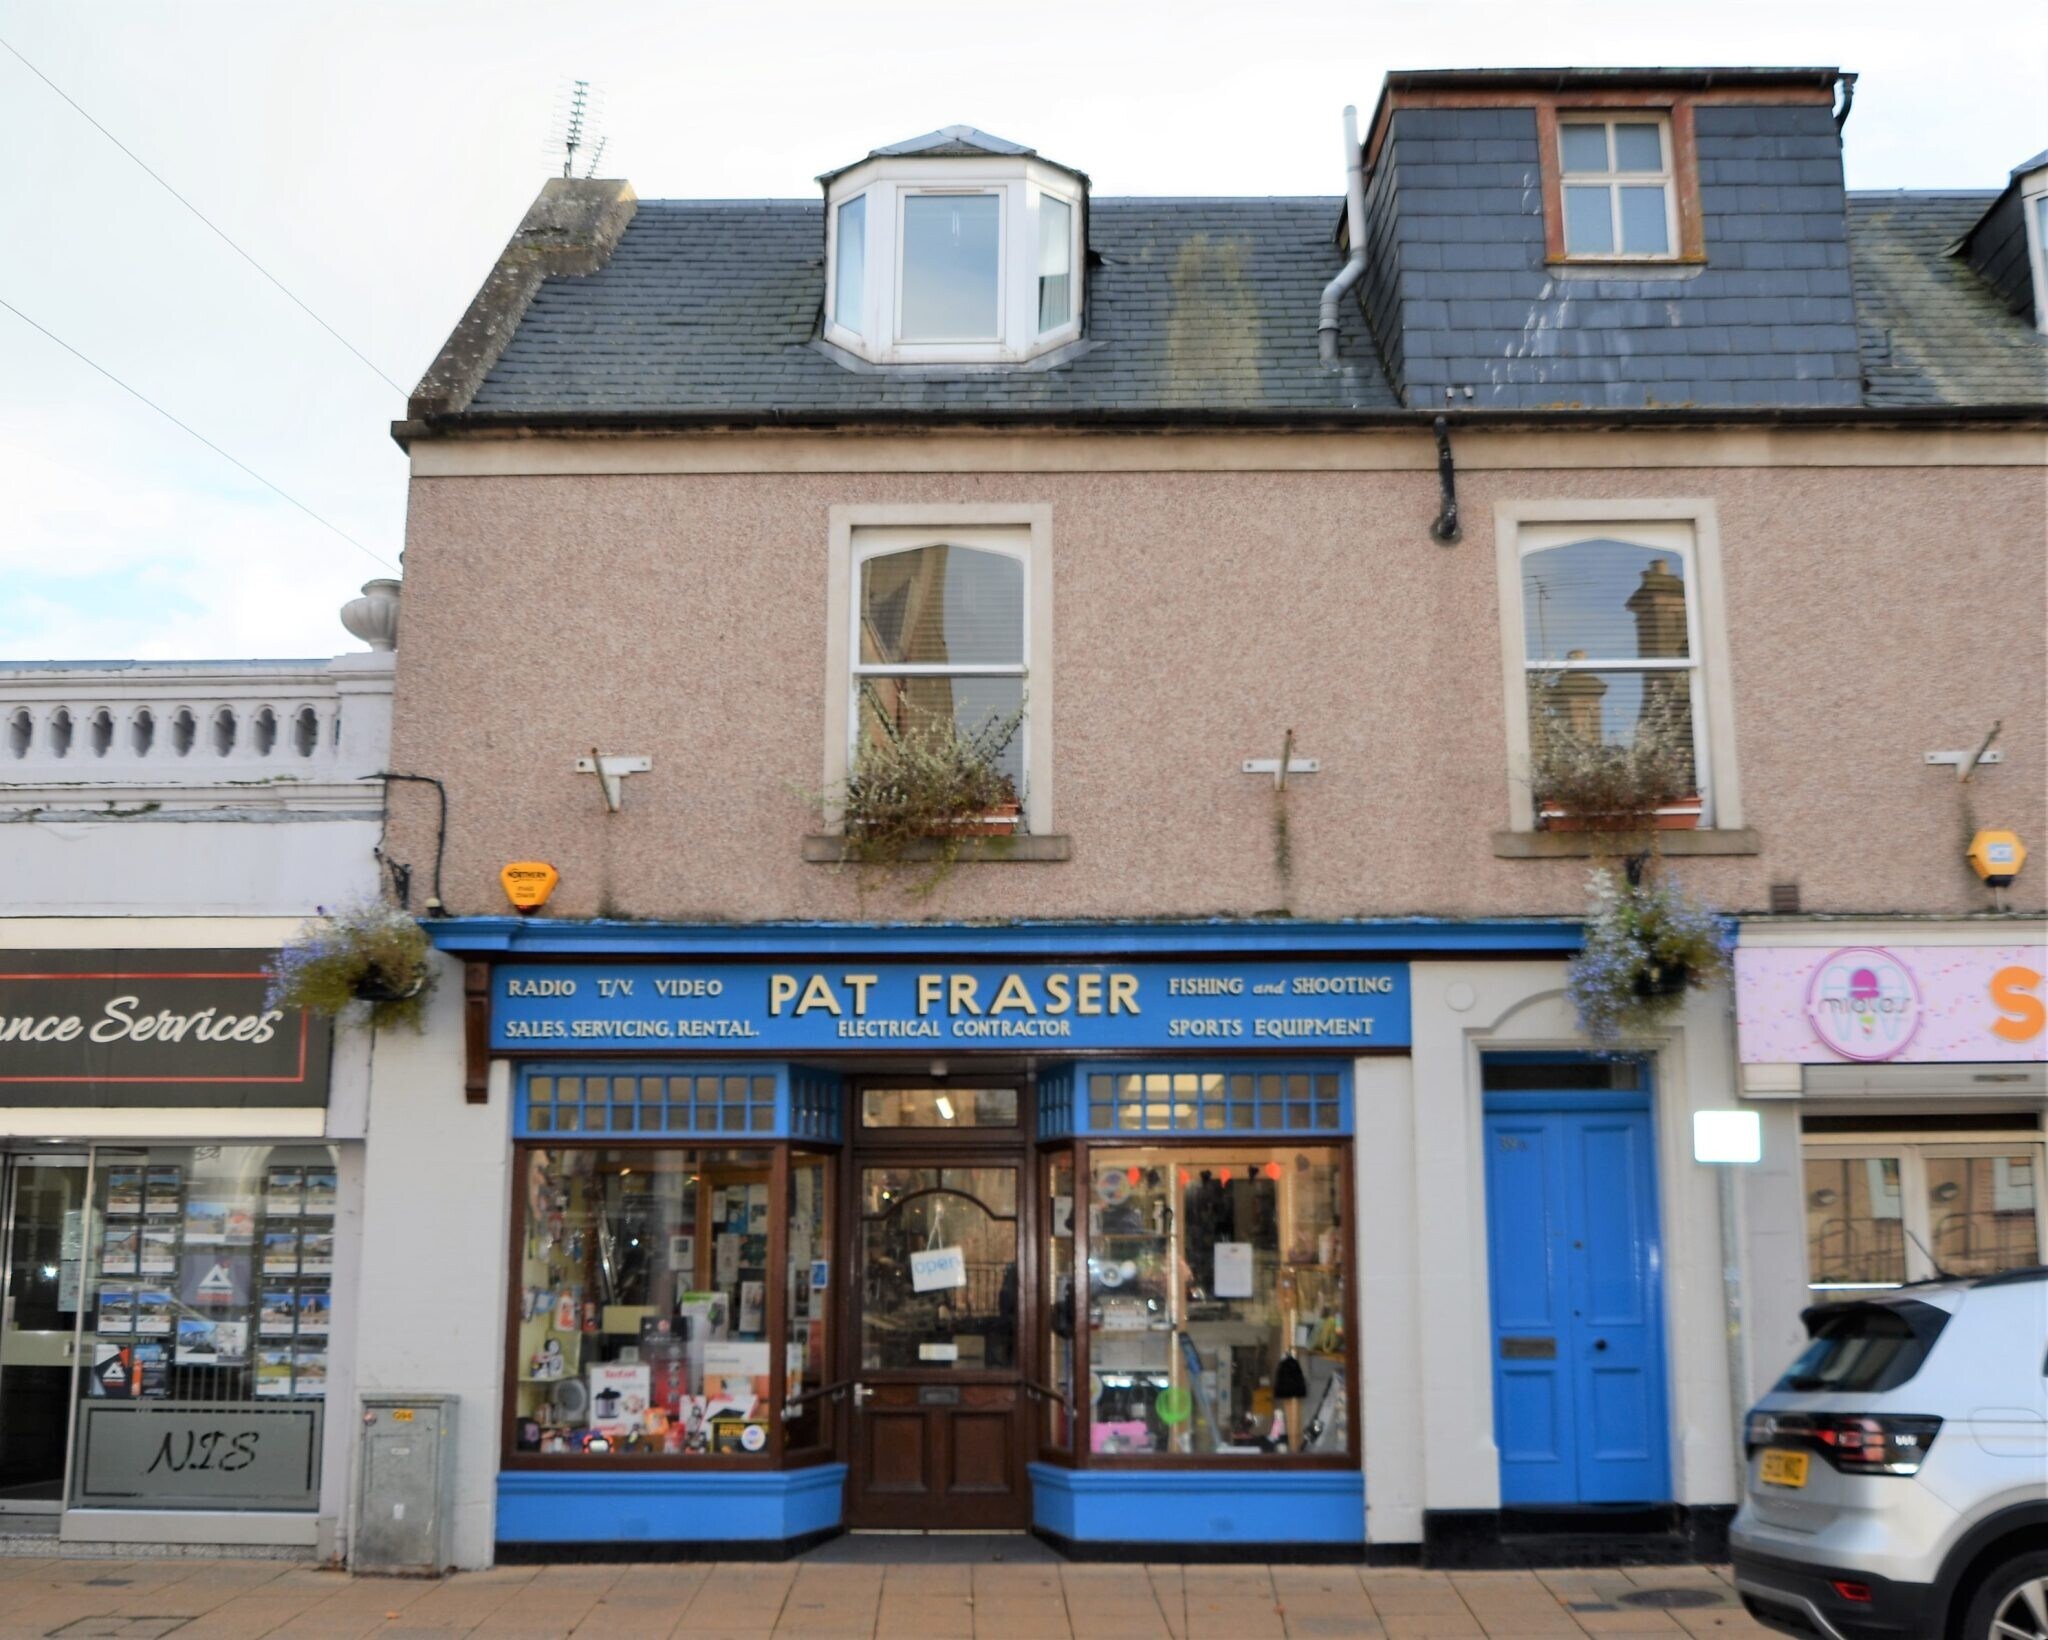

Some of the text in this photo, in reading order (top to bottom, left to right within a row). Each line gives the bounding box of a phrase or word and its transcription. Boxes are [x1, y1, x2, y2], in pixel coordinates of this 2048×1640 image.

[508, 979, 576, 996] RADIO
[655, 979, 723, 996] VIDEO
[768, 973, 1142, 1016] PAT FRASER
[1168, 976, 1393, 995] FISHING and SHOOTING
[89, 996, 284, 1044] Services
[838, 1020, 1071, 1037] ELECTRICAL CONTRACTOR
[1168, 1018, 1374, 1038] SPORTS EQUIPMENT
[914, 1257, 960, 1276] open
